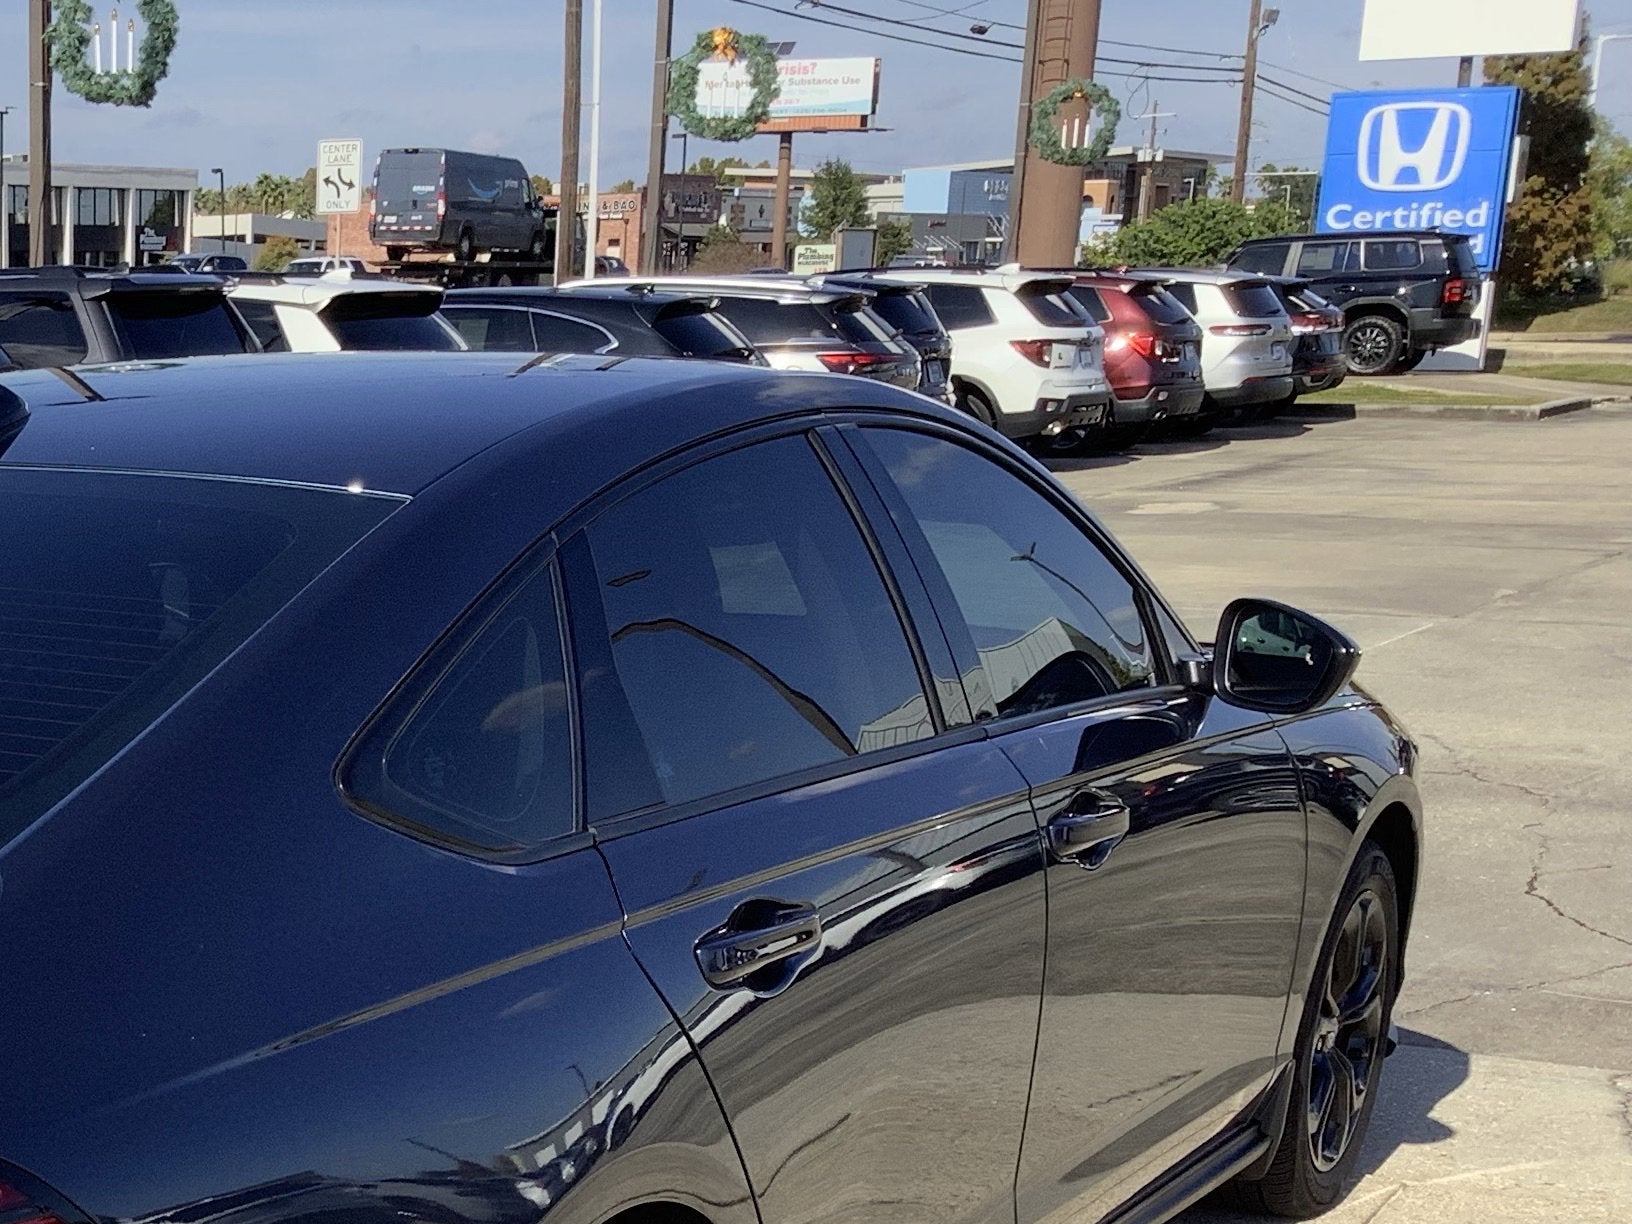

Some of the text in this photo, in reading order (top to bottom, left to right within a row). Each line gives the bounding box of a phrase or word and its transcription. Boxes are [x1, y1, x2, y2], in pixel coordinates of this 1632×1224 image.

[778, 62, 818, 75] risis?
[788, 76, 839, 87] Substance
[841, 76, 861, 86] Use
[322, 144, 358, 154] CENTER
[327, 154, 352, 164] LANE
[326, 200, 351, 209] ONLY
[613, 199, 636, 211] BAO
[1326, 202, 1489, 230] Certified
